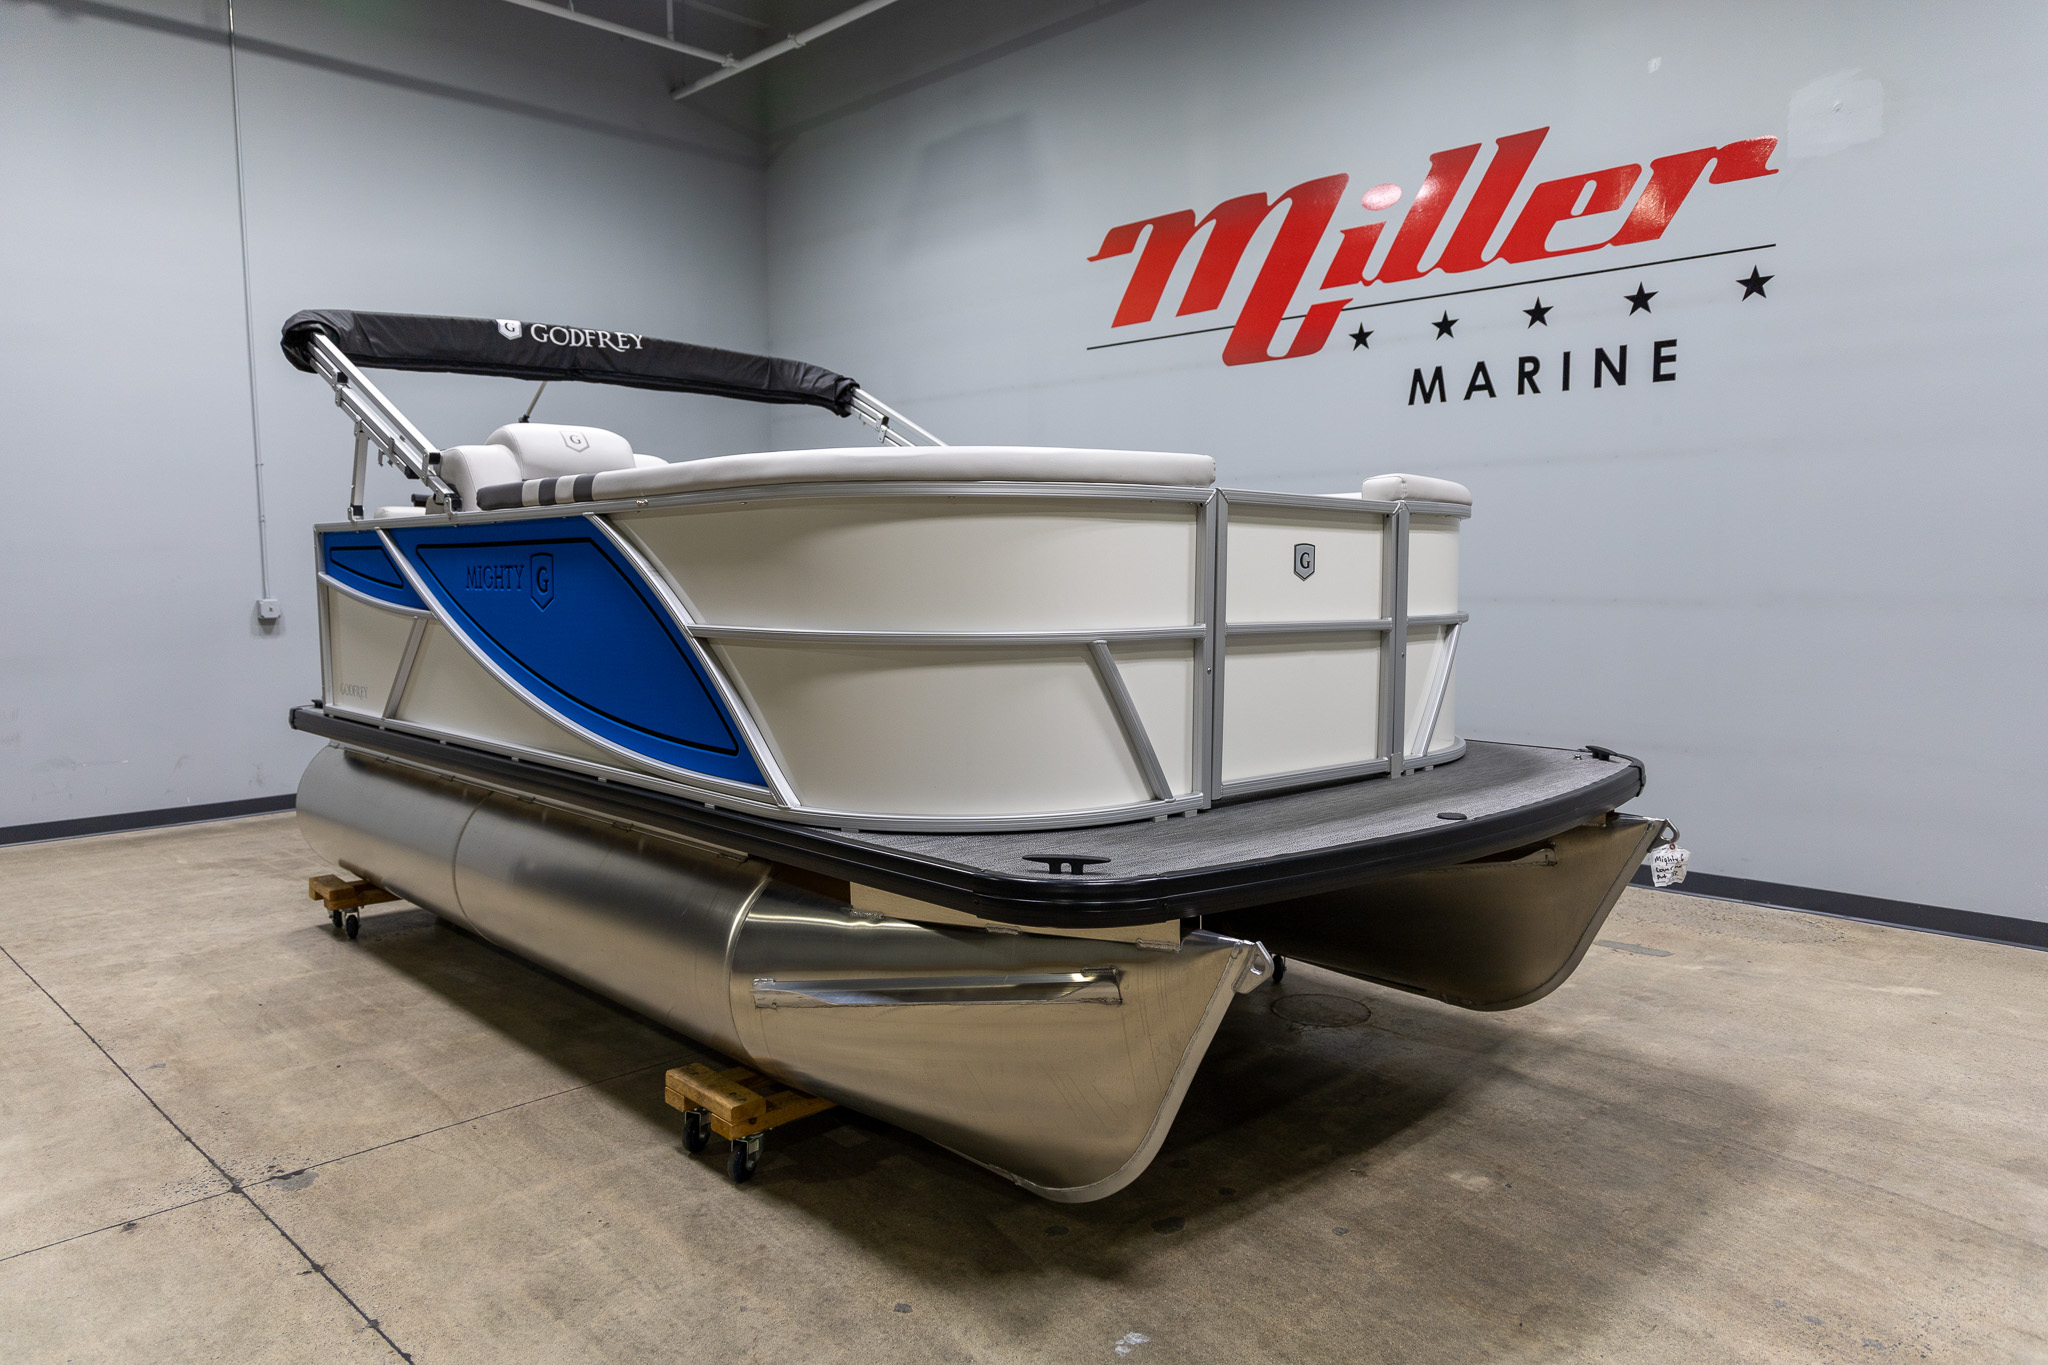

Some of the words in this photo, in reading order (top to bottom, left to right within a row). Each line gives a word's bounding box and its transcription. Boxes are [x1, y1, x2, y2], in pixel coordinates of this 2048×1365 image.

[1087, 126, 1779, 366] Miller
[530, 323, 643, 352] GODFREY
[1408, 339, 1678, 406] MARINE
[1299, 551, 1311, 569] G
[465, 564, 525, 592] MIGHTY
[536, 566, 550, 595] G
[339, 682, 369, 700] GODFREY
